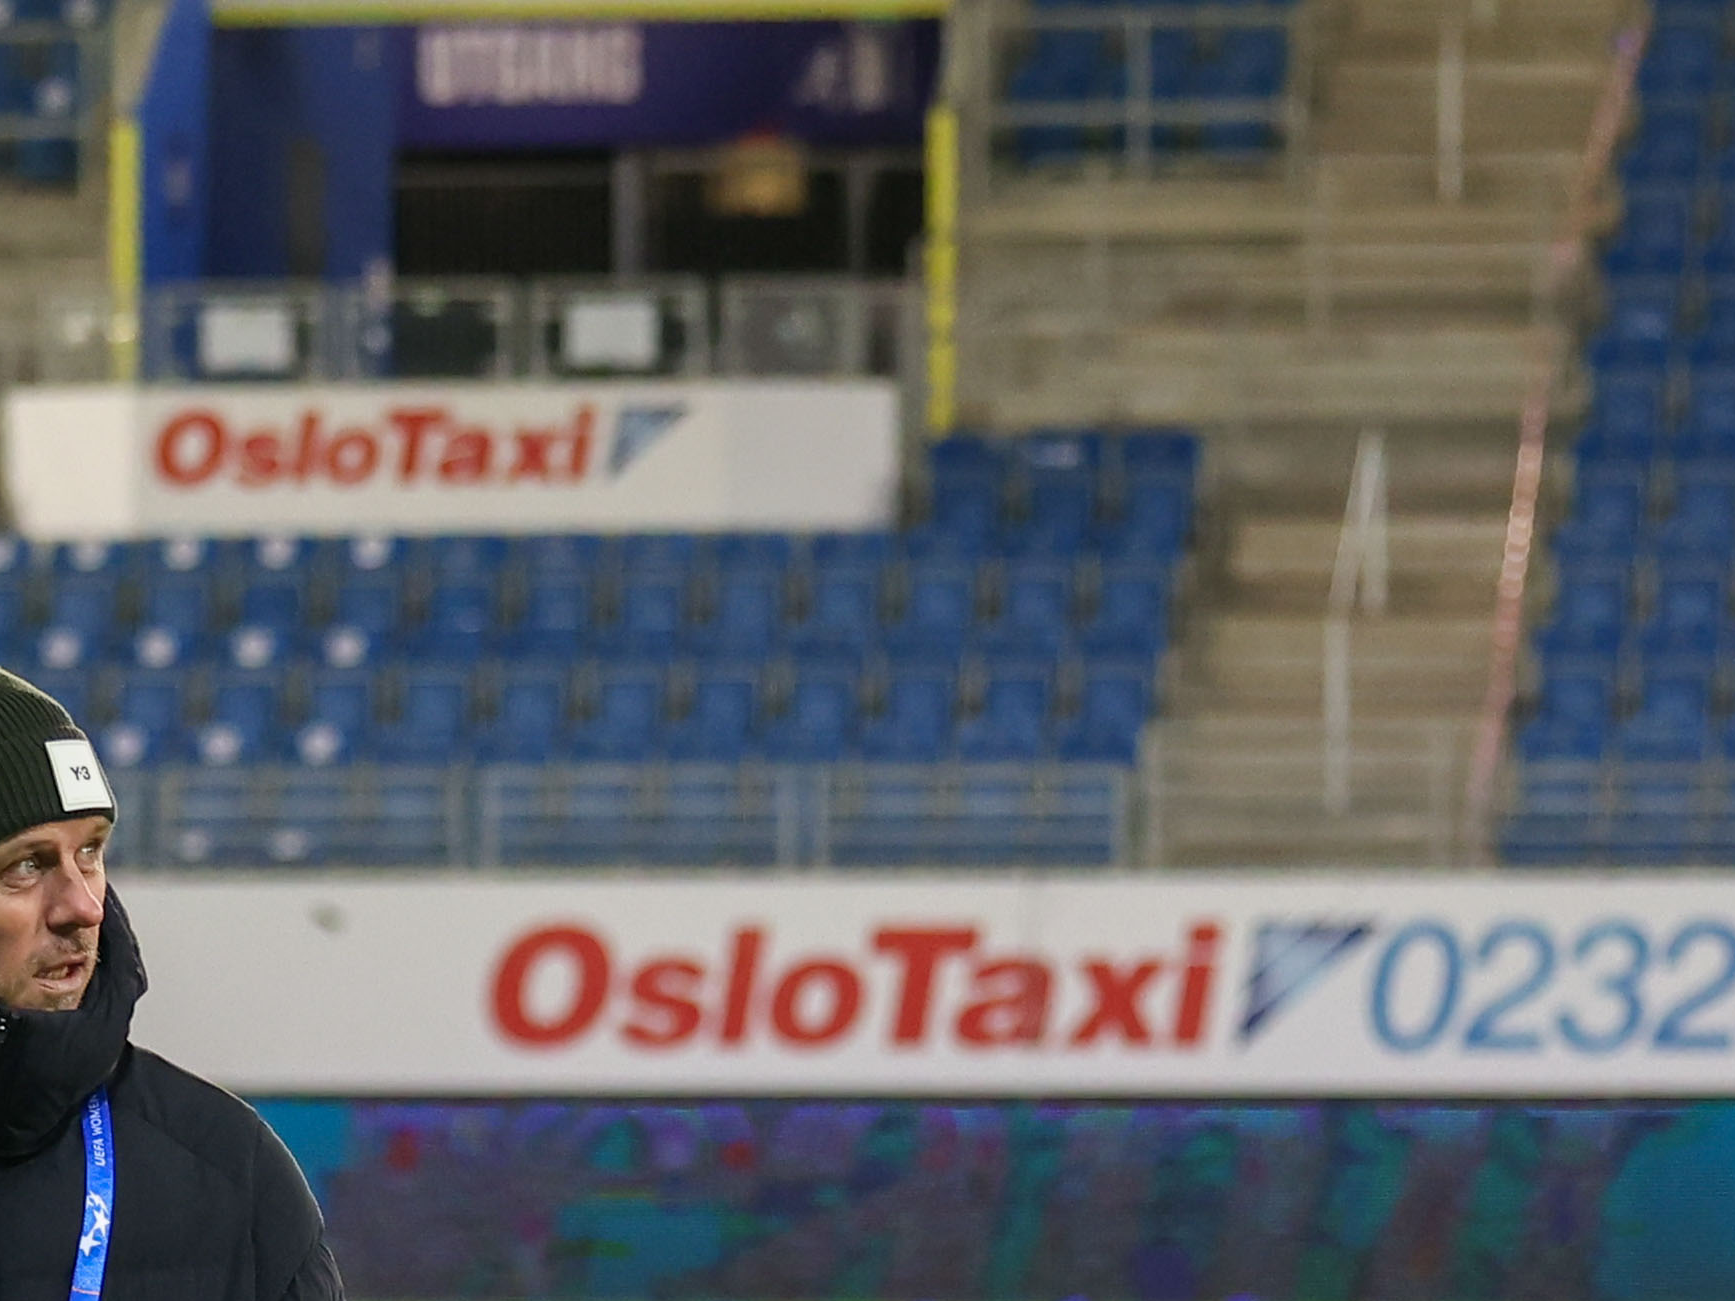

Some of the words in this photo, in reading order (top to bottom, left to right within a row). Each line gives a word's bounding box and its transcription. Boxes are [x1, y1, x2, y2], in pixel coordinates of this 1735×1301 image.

[154, 406, 593, 486] OsloTaxi
[69, 765, 91, 781] Y-3
[489, 922, 1220, 1051] OsloTaxi
[92, 1138, 106, 1167] UEFA
